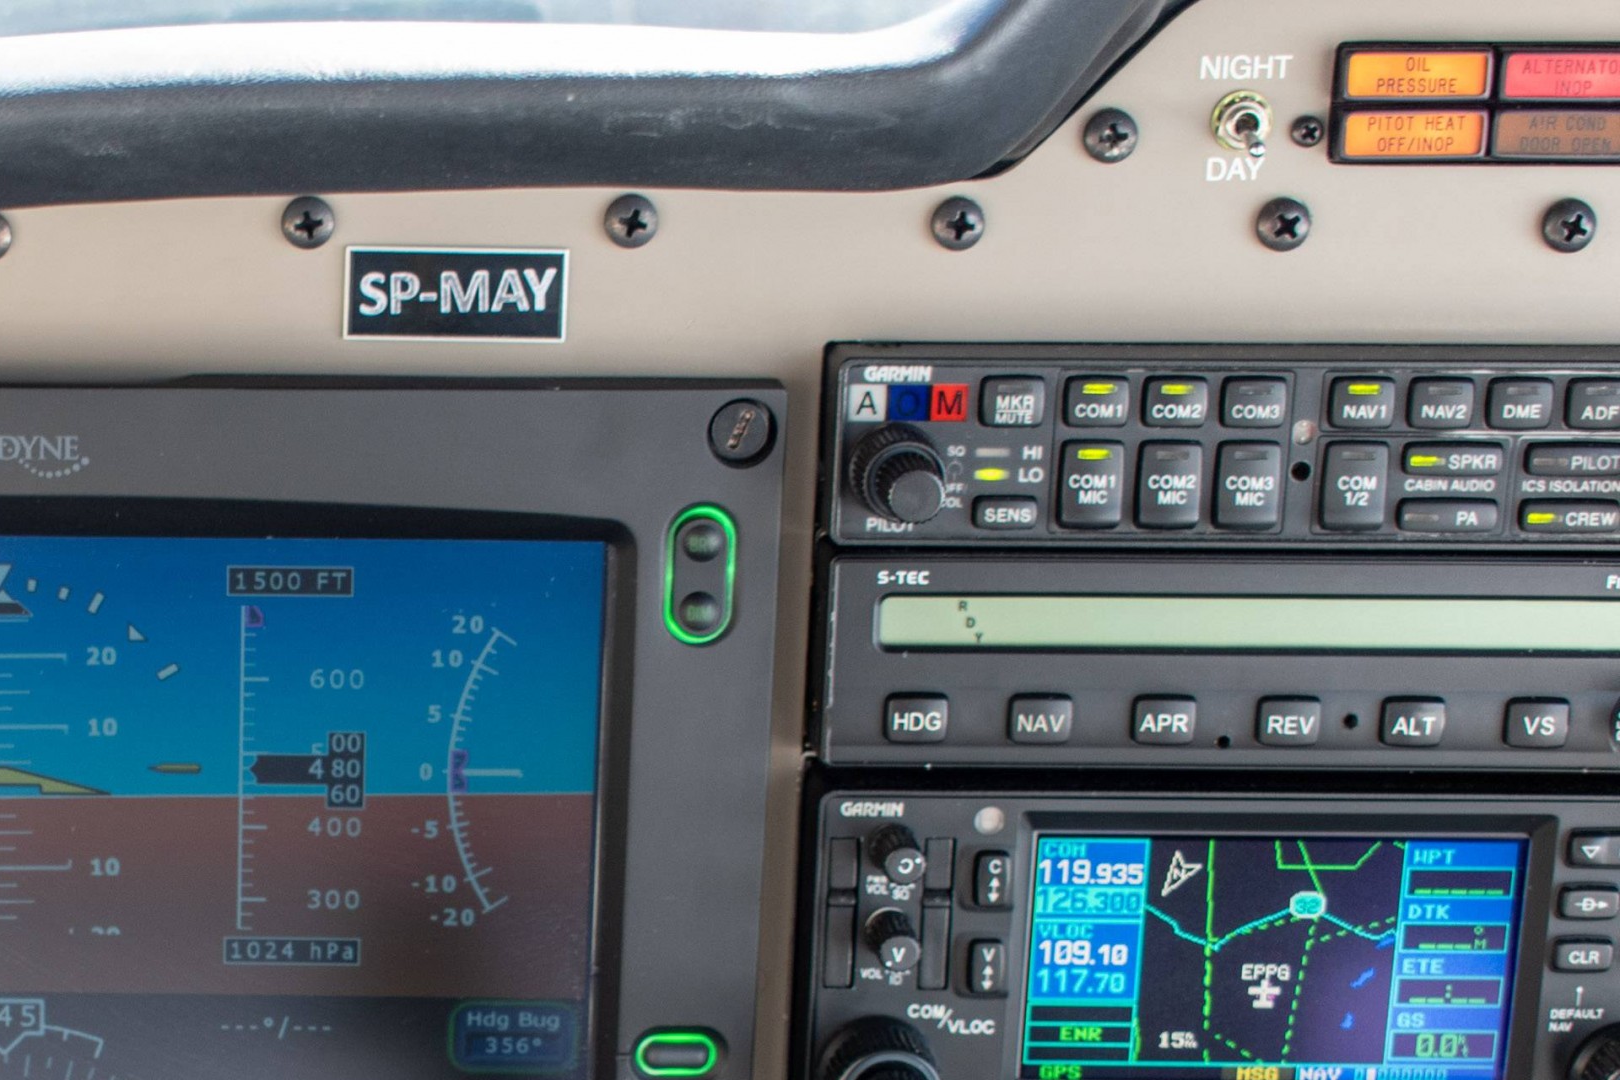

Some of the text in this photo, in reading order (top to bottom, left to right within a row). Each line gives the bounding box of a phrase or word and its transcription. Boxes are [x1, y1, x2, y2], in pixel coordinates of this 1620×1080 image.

[1200, 54, 1293, 80] NIGHT
[1406, 58, 1430, 73] OIL
[1376, 79, 1457, 94] PRESSURE
[1367, 116, 1465, 131] PITOT HEAT
[1377, 138, 1454, 152] OFF/INOP
[1206, 156, 1264, 181] DAY
[359, 268, 556, 315] SP-MAY
[863, 367, 931, 382] GARMIN
[1075, 404, 1122, 418] COM1
[1152, 404, 1202, 418] COM2
[1231, 405, 1280, 419] COM3
[1421, 405, 1466, 419] NAV2
[1448, 455, 1496, 470] SPKR
[1068, 474, 1115, 488] COM1
[1148, 475, 1195, 489] COM2
[1158, 491, 1187, 505] MIC
[1235, 492, 1264, 506] MIC
[984, 508, 1031, 522] SENS
[1456, 512, 1478, 526] PA
[1565, 512, 1615, 526] CREW
[235, 573, 347, 590] 1500 FT
[453, 616, 484, 634] 20
[86, 648, 116, 665] 20
[433, 651, 462, 667] 10
[310, 670, 364, 689] 600
[88, 719, 118, 736] 10
[893, 712, 941, 731] HDG
[1017, 714, 1065, 732] NAV
[1139, 715, 1188, 733] APR
[1267, 716, 1315, 735] REV
[1391, 717, 1436, 735] ALT
[1523, 716, 1555, 735] VS
[840, 802, 904, 817] GARMIN
[308, 818, 361, 836] 400
[91, 858, 120, 875] 10
[1039, 860, 1143, 884] 119.935
[308, 891, 360, 909] 300
[1039, 924, 1093, 938] VLOC
[231, 943, 354, 959] 1024 hPa
[1039, 940, 1128, 965] 109.10
[1242, 965, 1289, 980] EPPG
[1402, 959, 1443, 974] ETE
[1037, 970, 1124, 993] 117.70
[467, 1012, 560, 1030] Hdg Bug
[1398, 1013, 1424, 1027] GS
[1040, 1065, 1080, 1080] GPS
